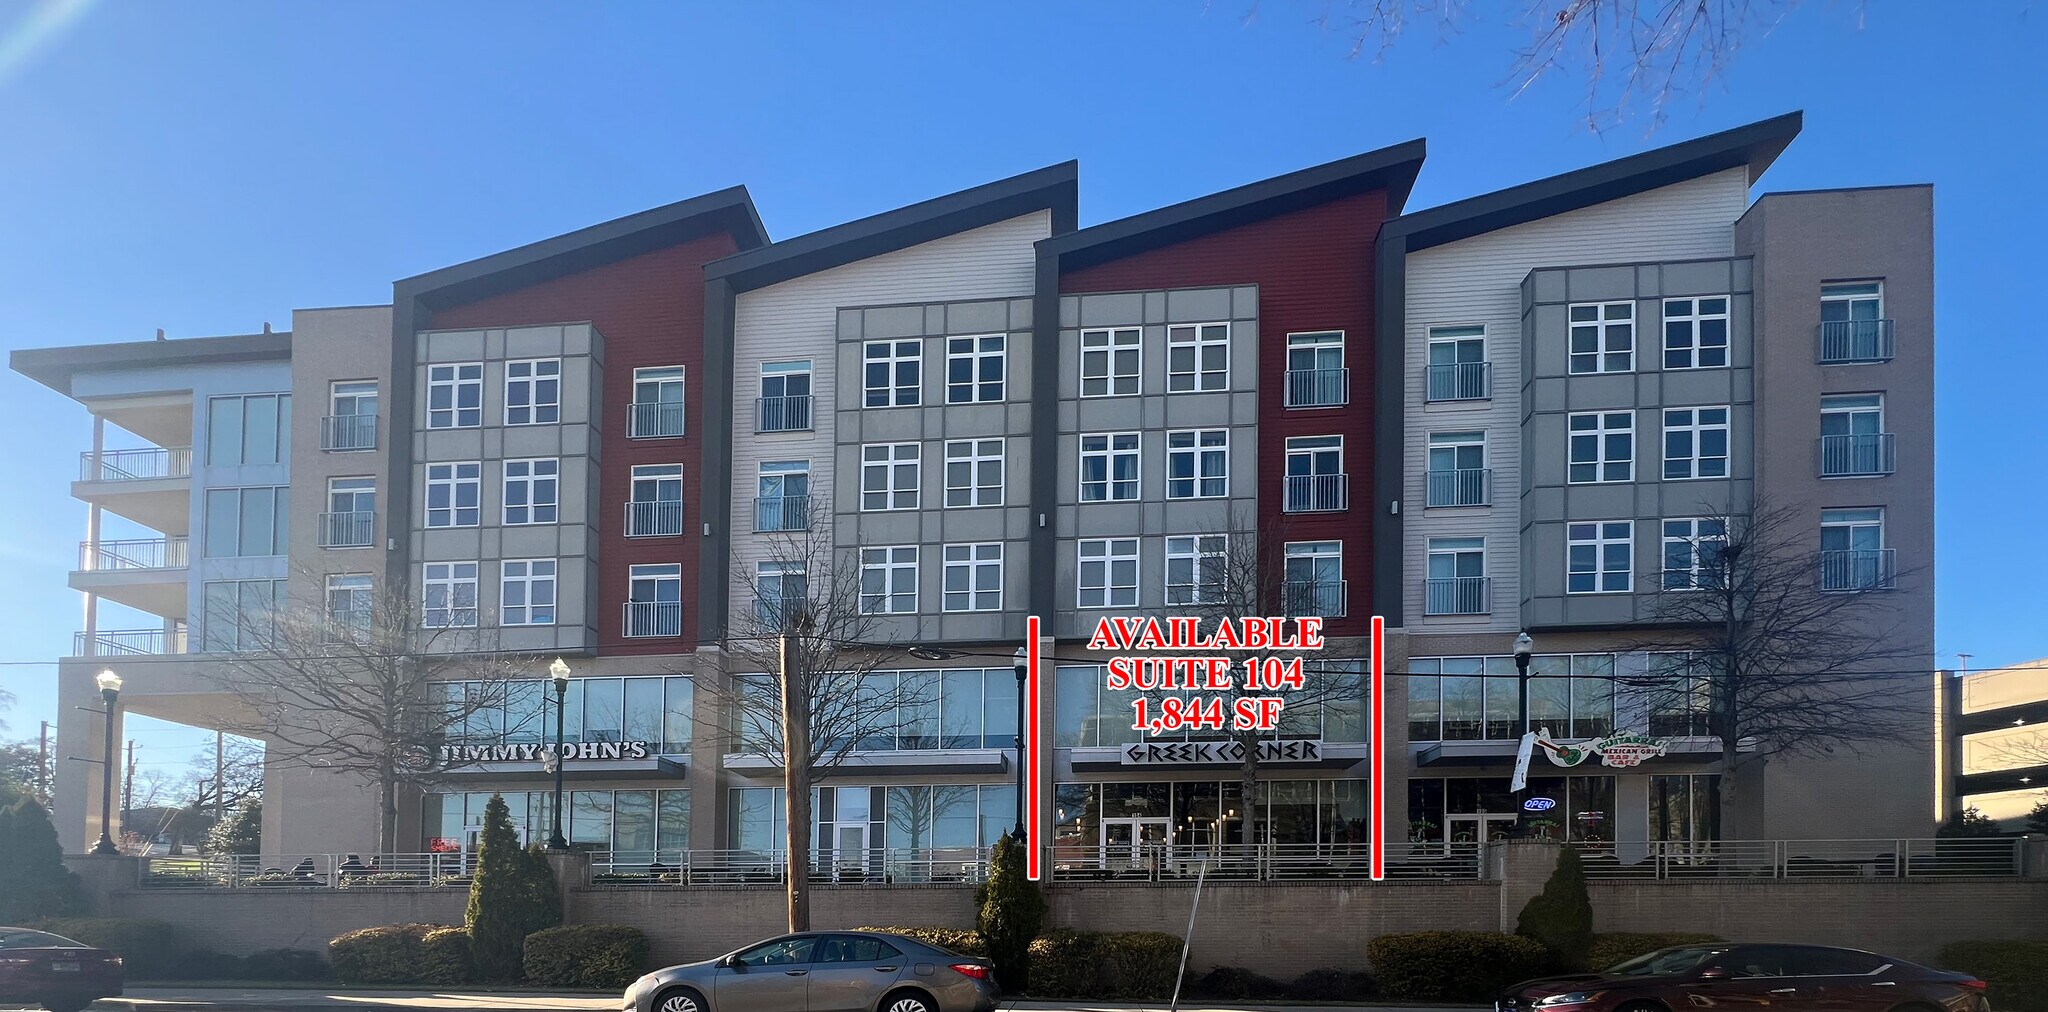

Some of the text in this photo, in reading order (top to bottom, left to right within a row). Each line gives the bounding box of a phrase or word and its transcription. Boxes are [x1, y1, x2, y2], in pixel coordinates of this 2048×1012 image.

[439, 743, 539, 766] JIMMY
[1126, 740, 1319, 763] GREEK CORNER
[1524, 799, 1552, 809] OPEN
